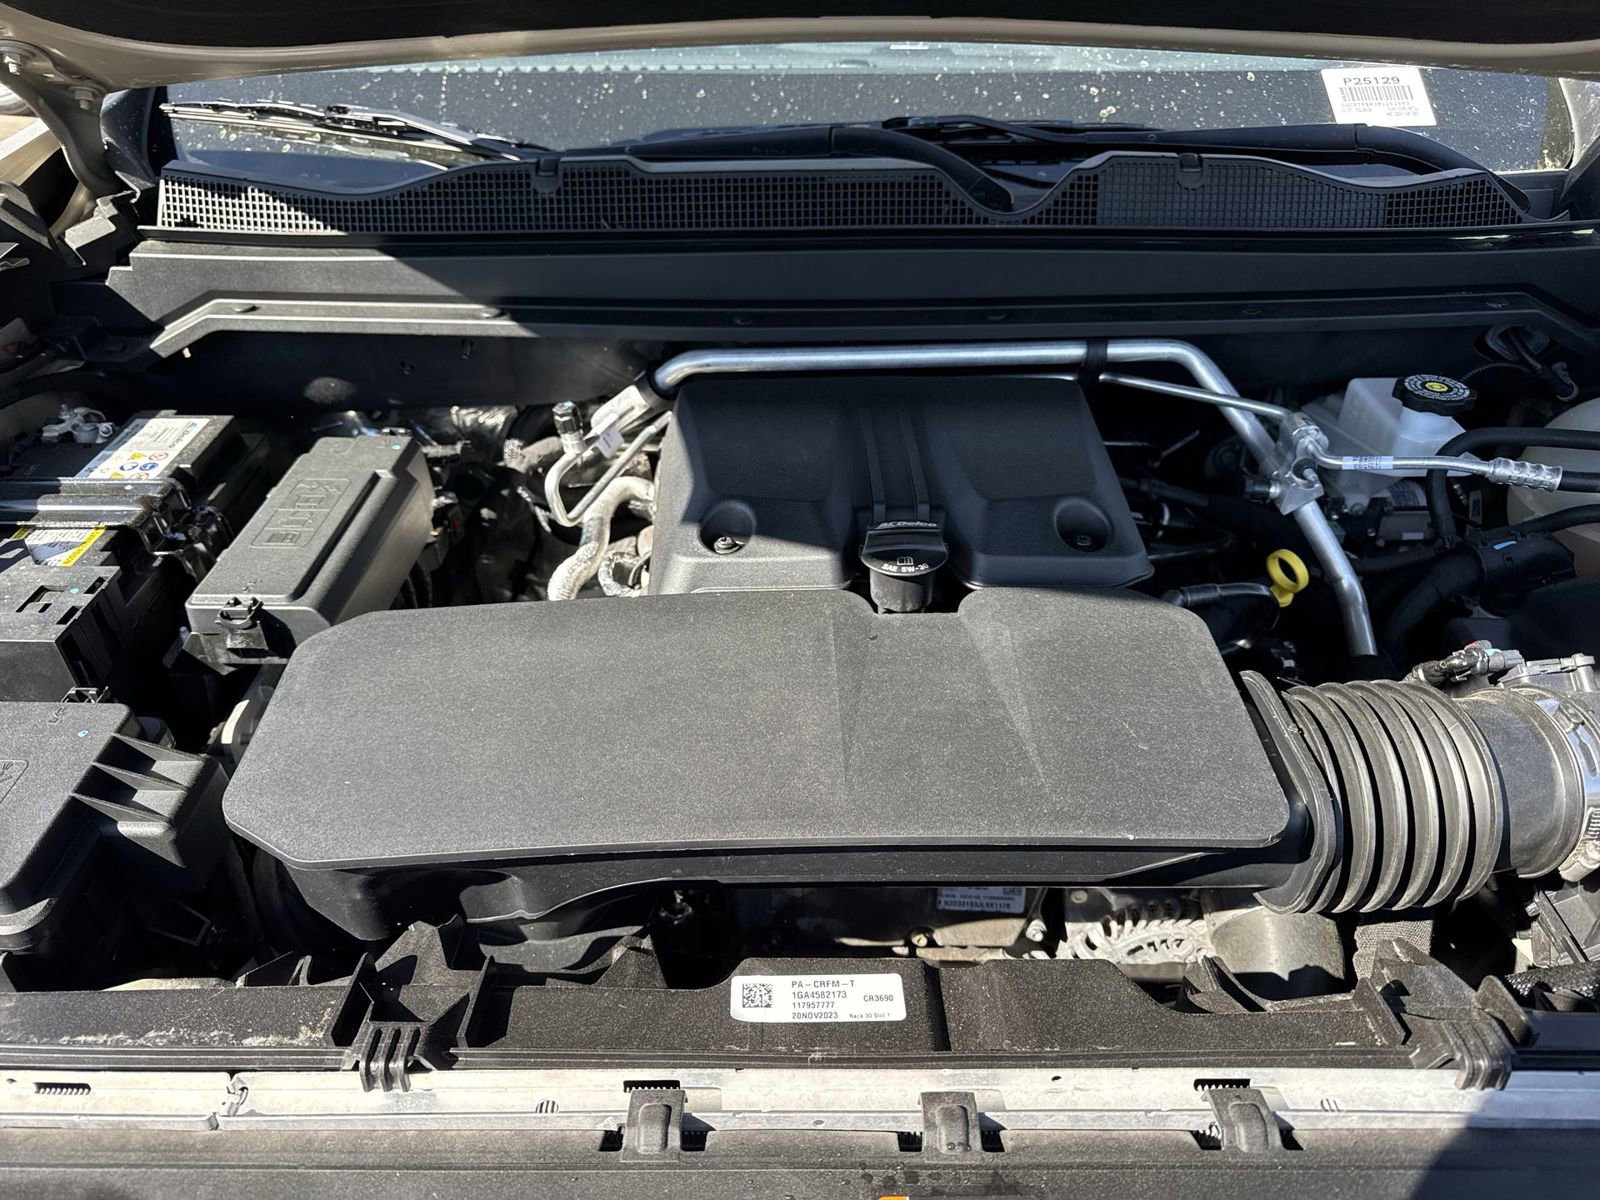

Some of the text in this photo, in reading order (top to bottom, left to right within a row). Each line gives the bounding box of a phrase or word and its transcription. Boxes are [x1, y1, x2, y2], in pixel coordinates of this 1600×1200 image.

[1343, 76, 1400, 86] P25129
[875, 521, 937, 529] ACDelco
[881, 563, 929, 572] SAE 5W-30
[792, 991, 847, 999] 1GA4582173
[863, 994, 894, 1002] CR3690
[791, 1012, 839, 1020] 20NOV2023
